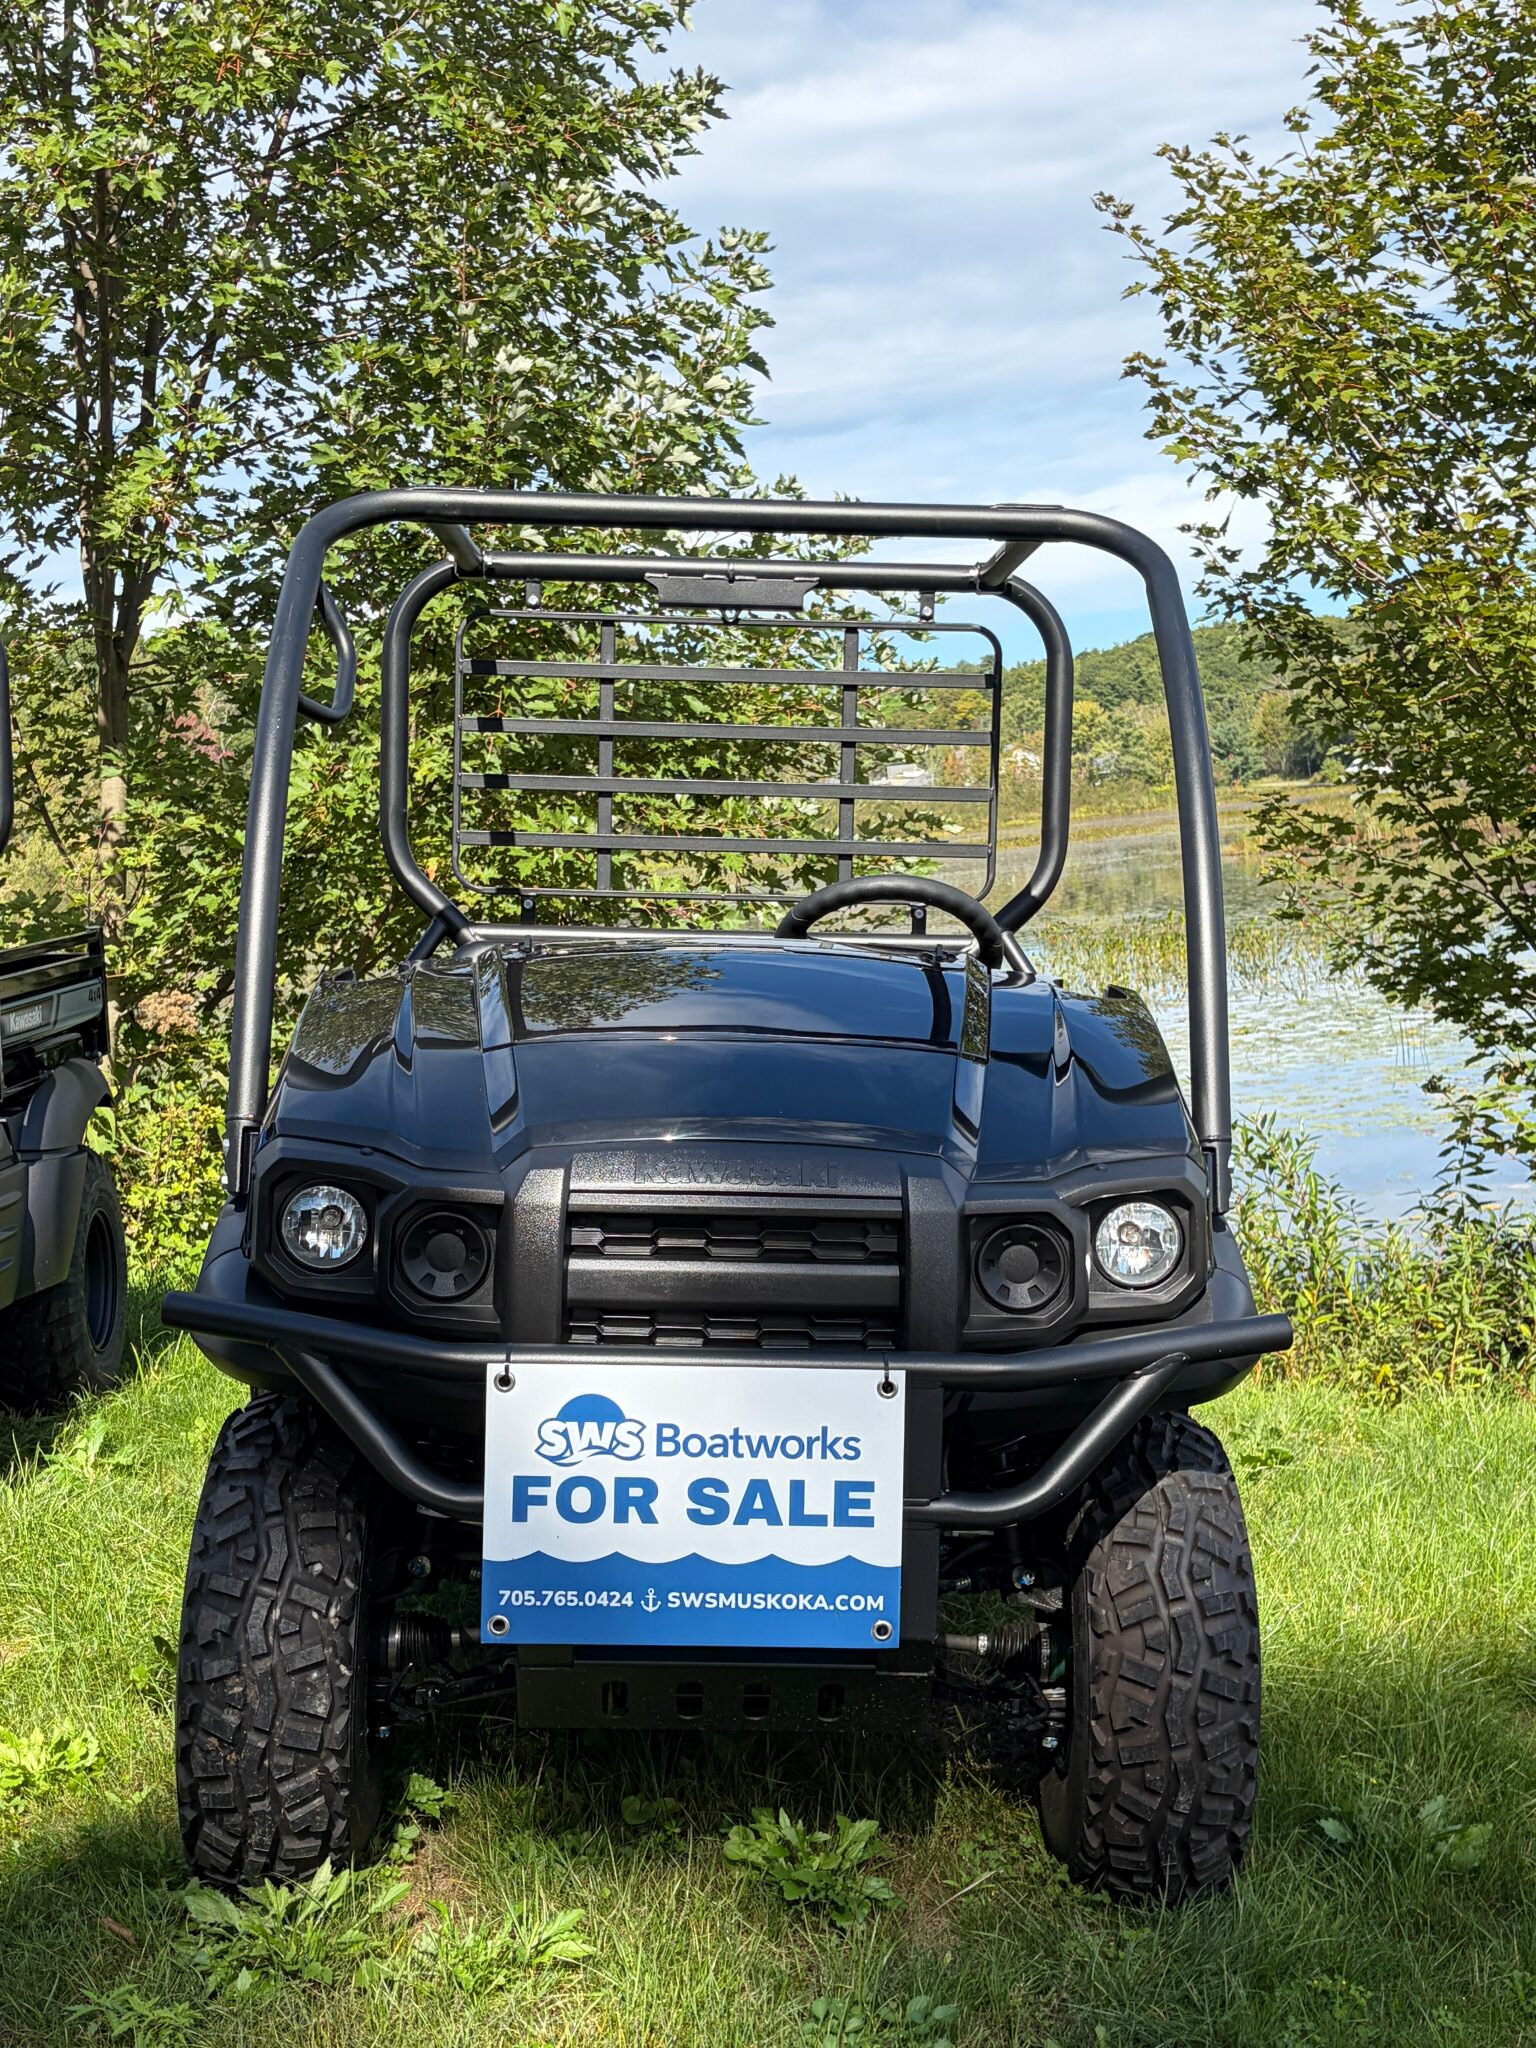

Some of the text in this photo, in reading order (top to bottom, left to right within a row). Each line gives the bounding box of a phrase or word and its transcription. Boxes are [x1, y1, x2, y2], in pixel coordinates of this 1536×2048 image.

[89, 988, 101, 1003] 4x4
[10, 1005, 42, 1033] Kawasaki
[634, 1154, 838, 1188] Kawasaki
[534, 1417, 861, 1465] SWS Boatworks
[512, 1475, 876, 1528] FOR SALE
[498, 1590, 885, 1613] 705.765.0424 SWSMUSKOKA.COM
